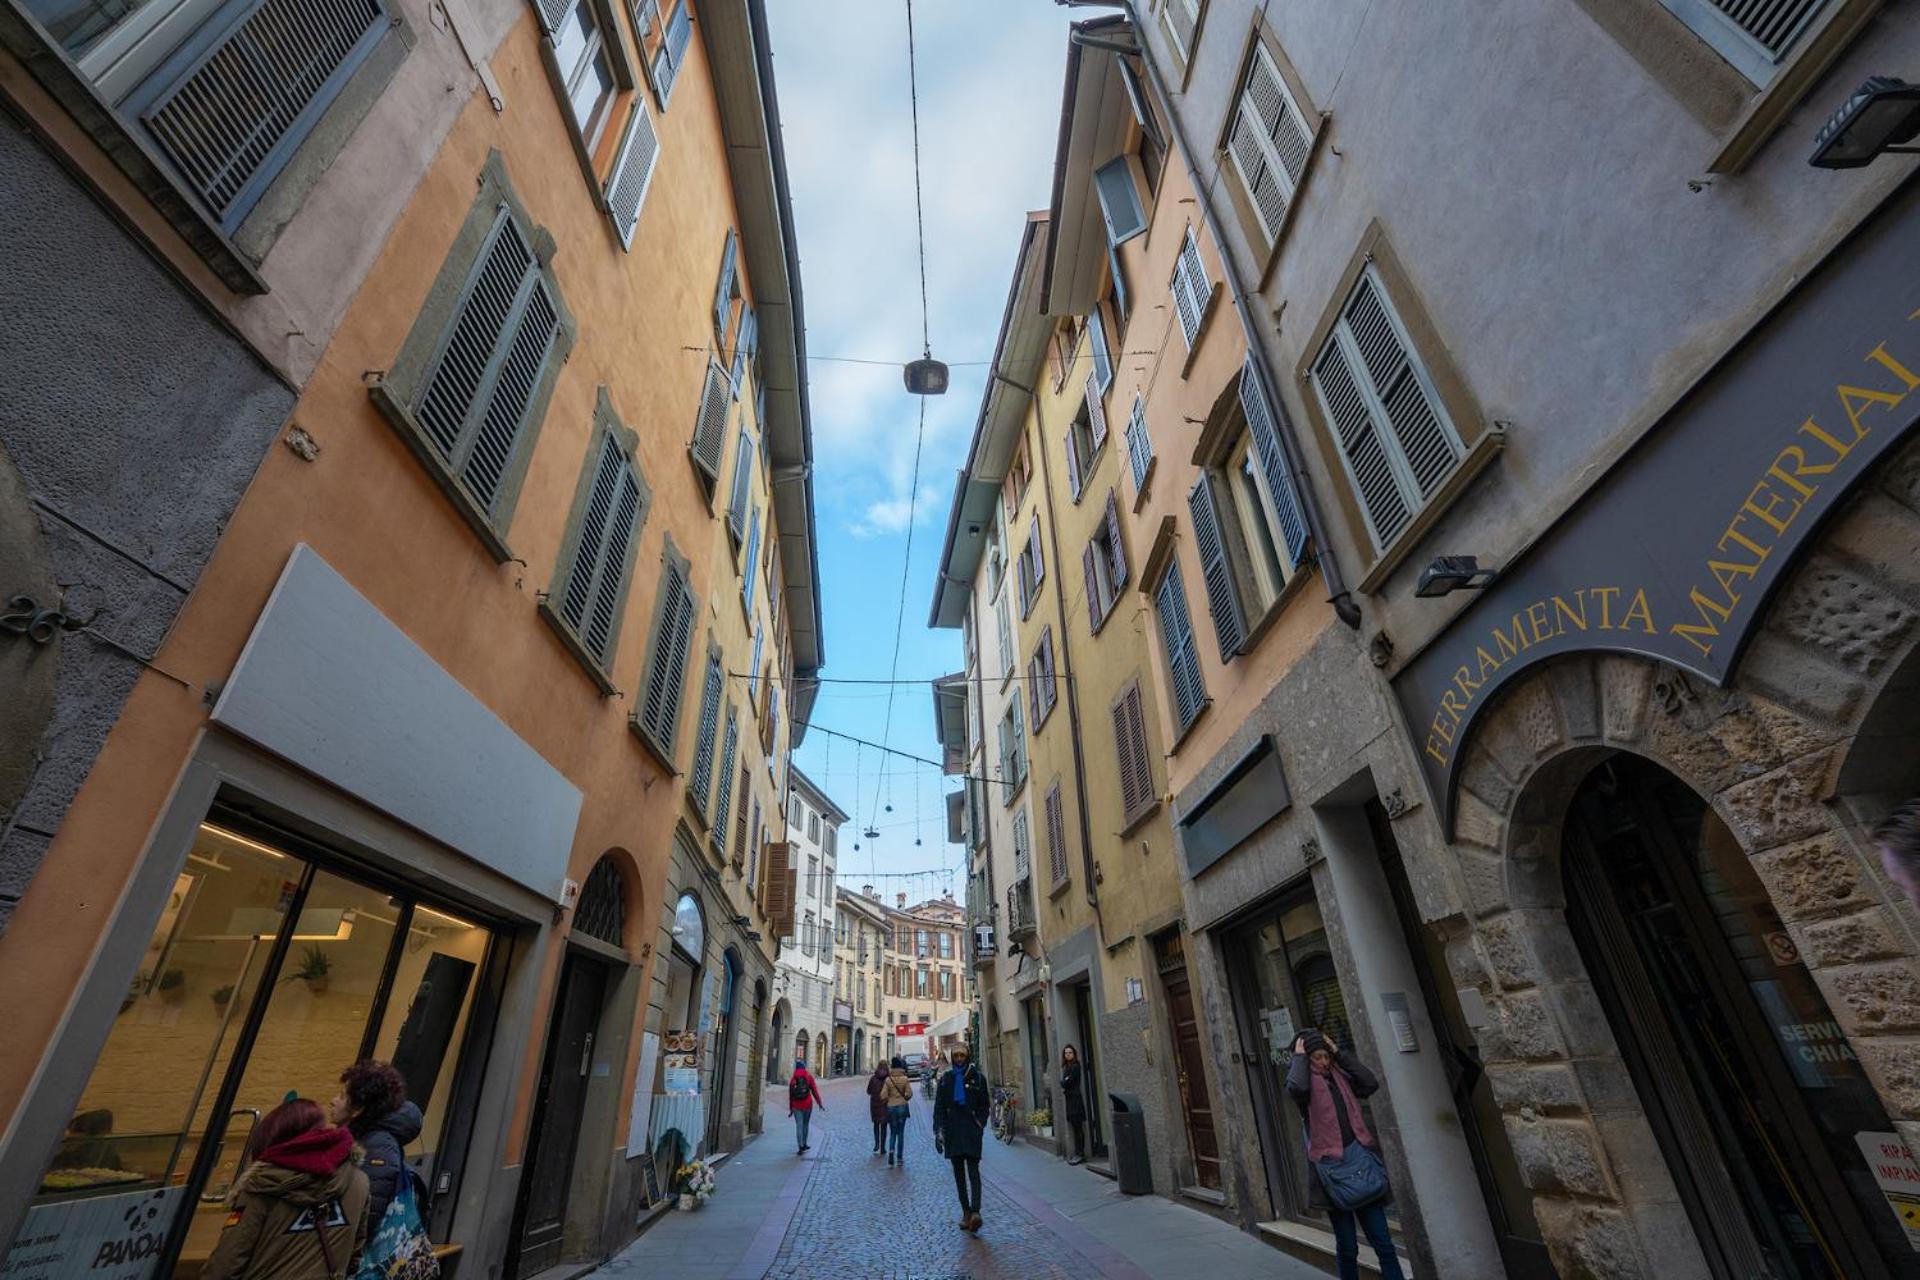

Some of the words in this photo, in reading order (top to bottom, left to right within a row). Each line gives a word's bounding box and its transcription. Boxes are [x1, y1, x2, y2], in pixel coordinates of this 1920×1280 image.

[1425, 586, 1659, 768] FERRAMENTA
[1669, 308, 1920, 660] MATERIAL
[91, 1232, 166, 1269] PANDA
